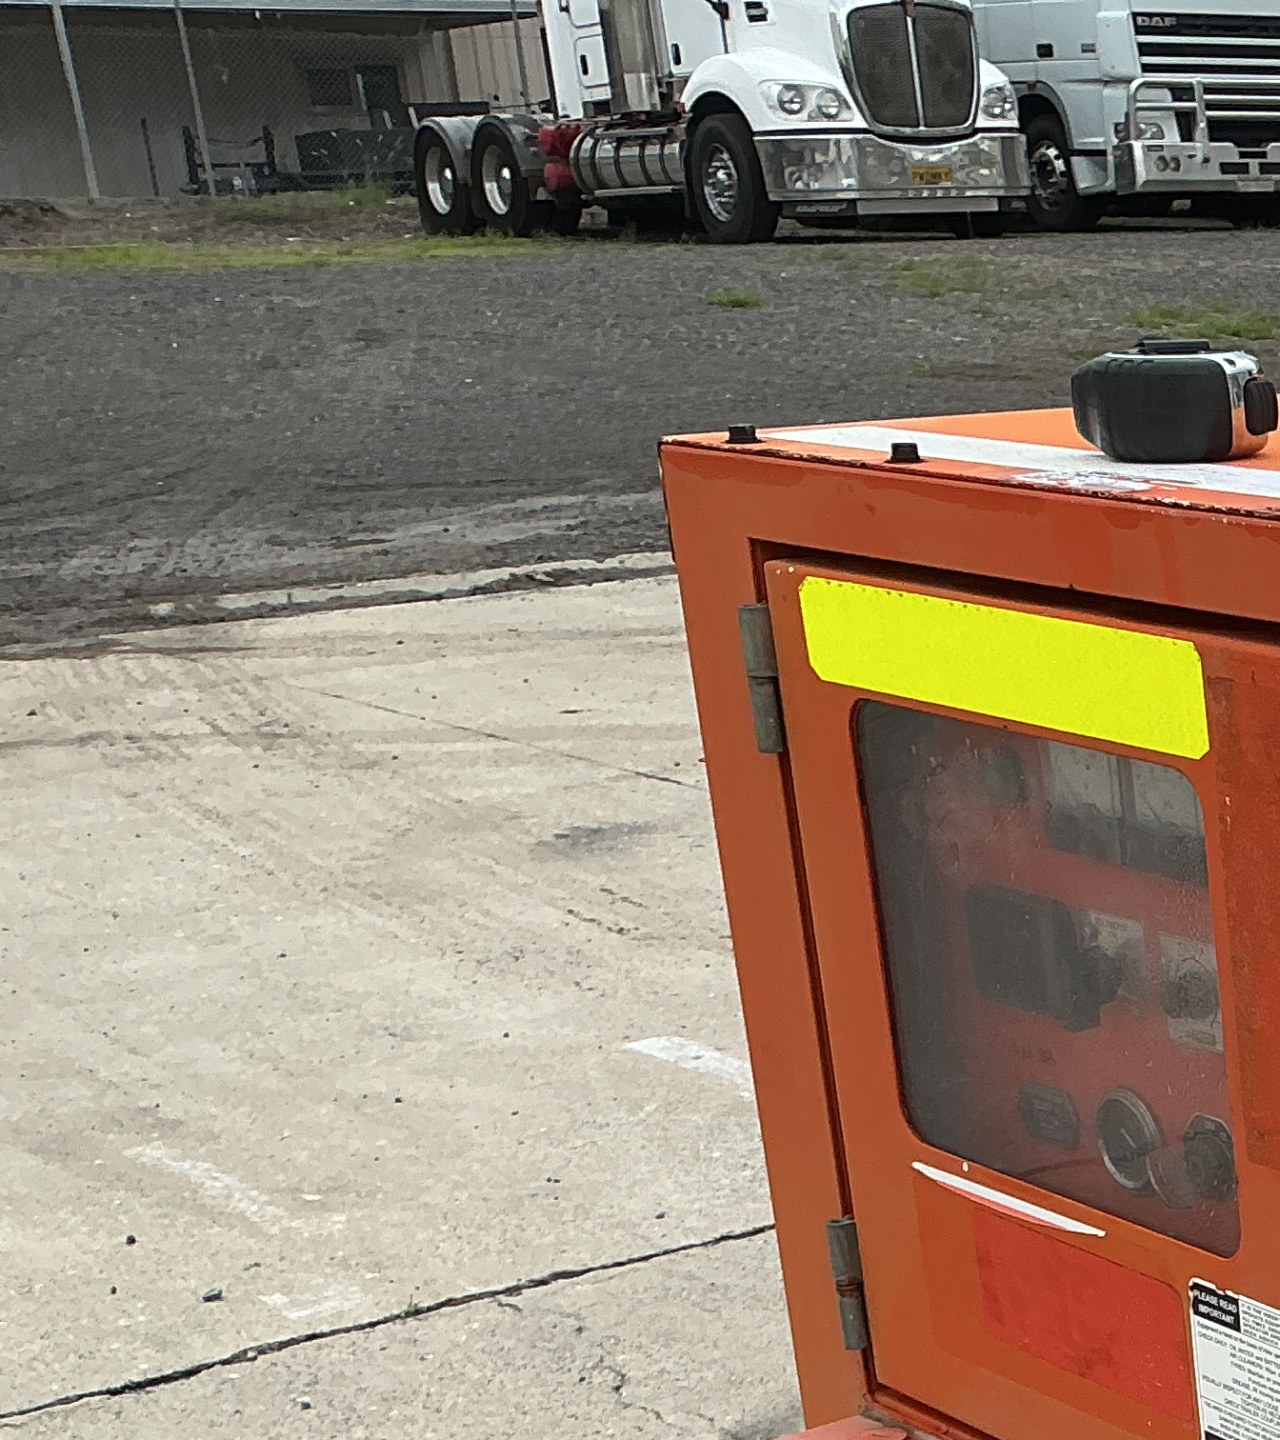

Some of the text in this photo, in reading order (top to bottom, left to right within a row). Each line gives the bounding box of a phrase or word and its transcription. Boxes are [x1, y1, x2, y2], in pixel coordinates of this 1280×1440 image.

[1136, 16, 1177, 27] DAF
[1193, 1289, 1238, 1314] PLEASE READ
[1197, 1304, 1235, 1324] IMPORTANT
